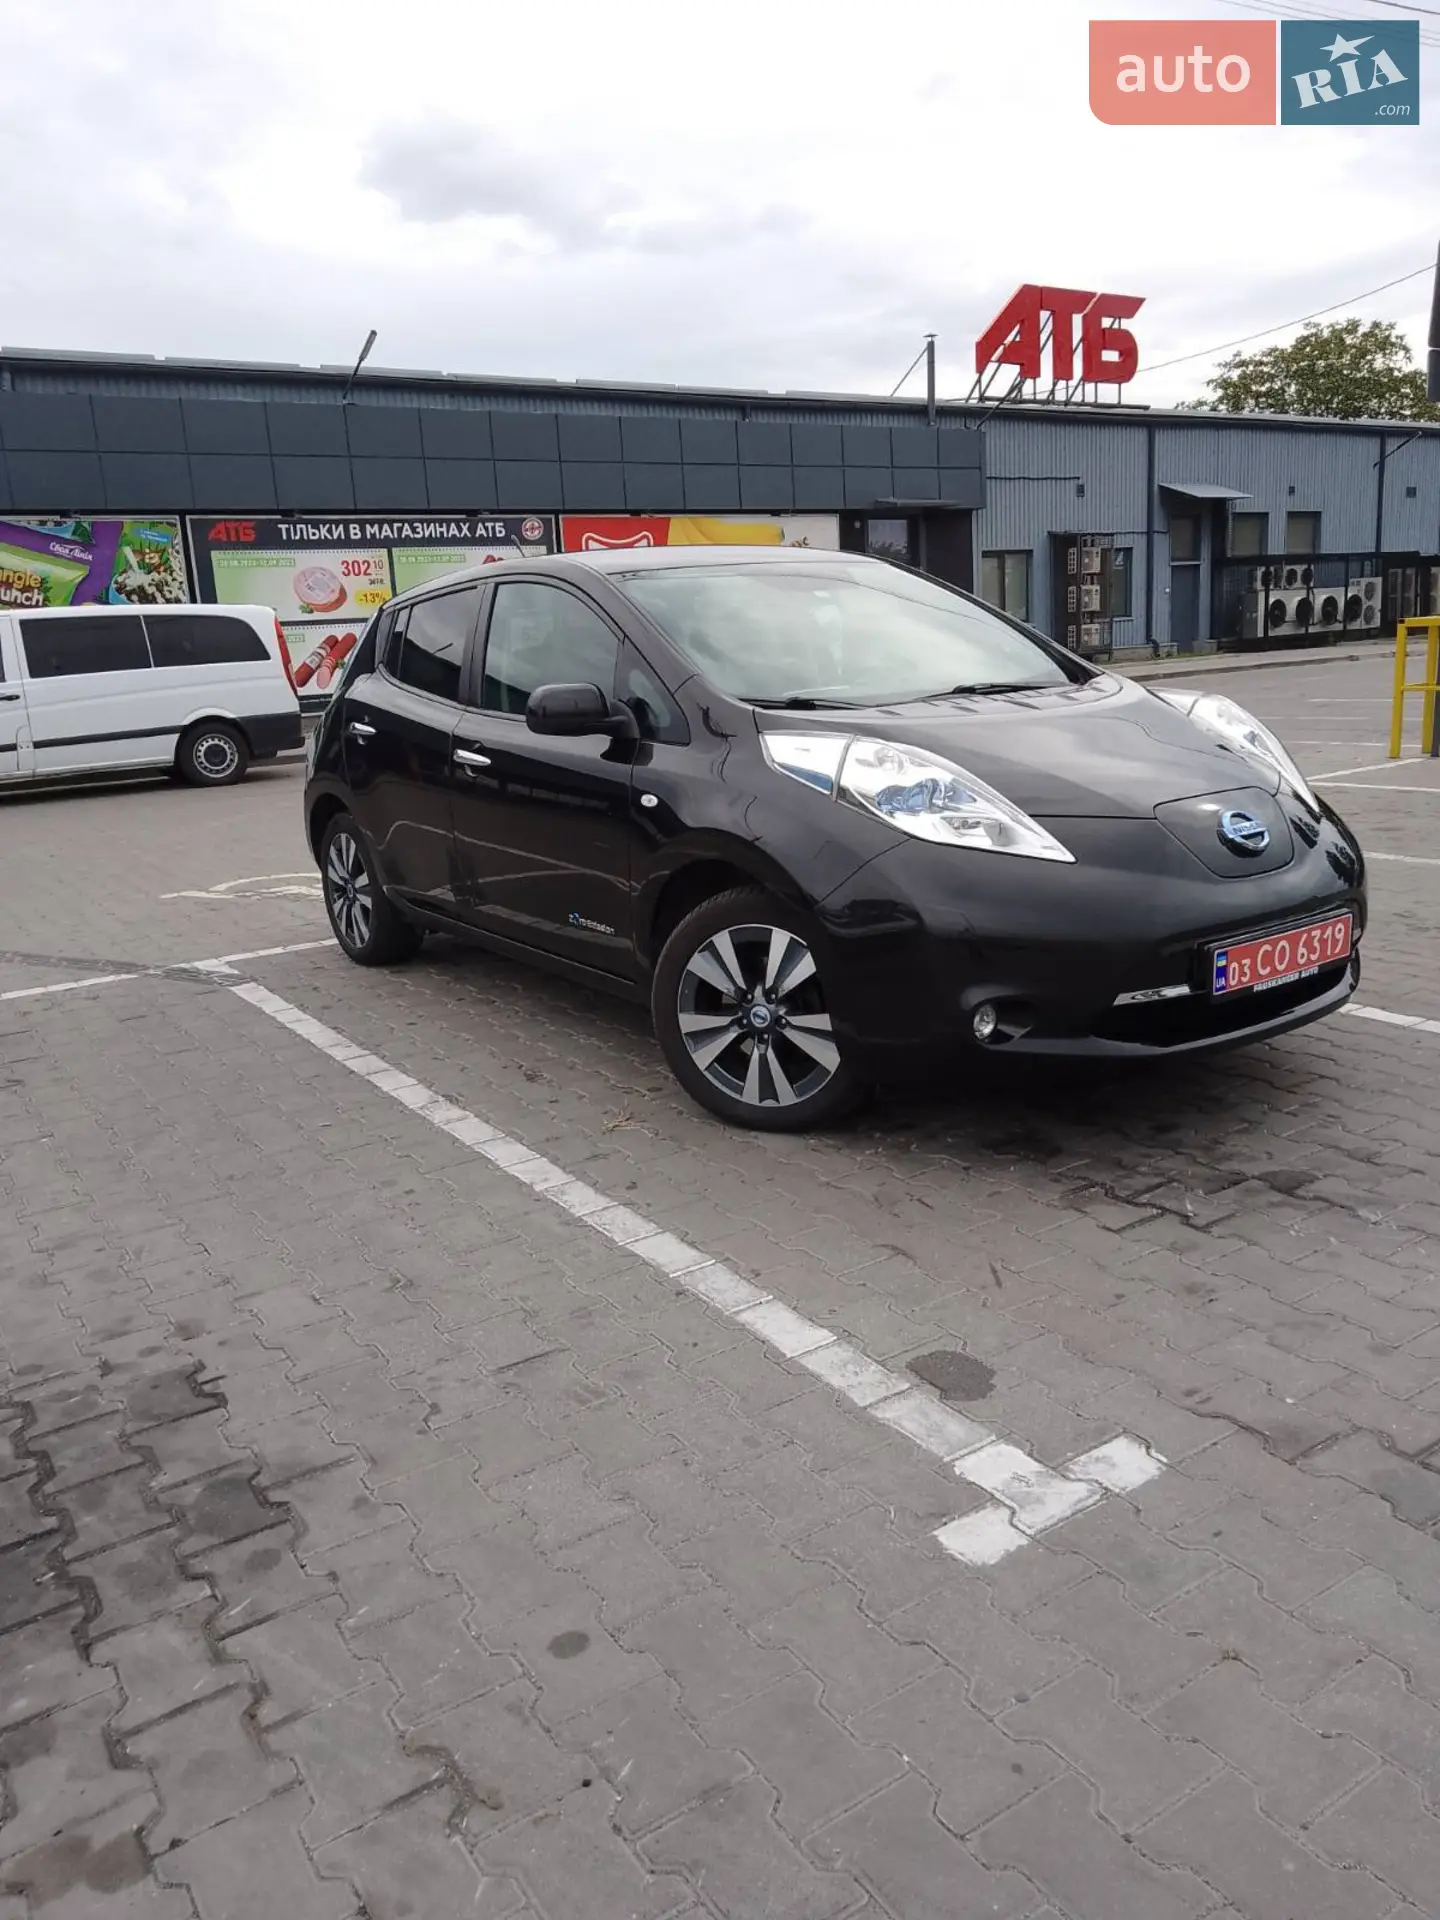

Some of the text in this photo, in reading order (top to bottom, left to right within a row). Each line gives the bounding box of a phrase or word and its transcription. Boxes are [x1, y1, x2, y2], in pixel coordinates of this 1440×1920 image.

[976, 284, 1146, 384] АТБ
[208, 520, 257, 542] АТБ
[278, 521, 506, 541] ТІЛЬКИ В МАГАЗИНАХ АТБ
[341, 559, 372, 577] 302
[373, 559, 384, 570] 10
[359, 592, 386, 604] -13%
[1229, 922, 1345, 986] 03 CO 6319
[1216, 977, 1226, 988] UA
